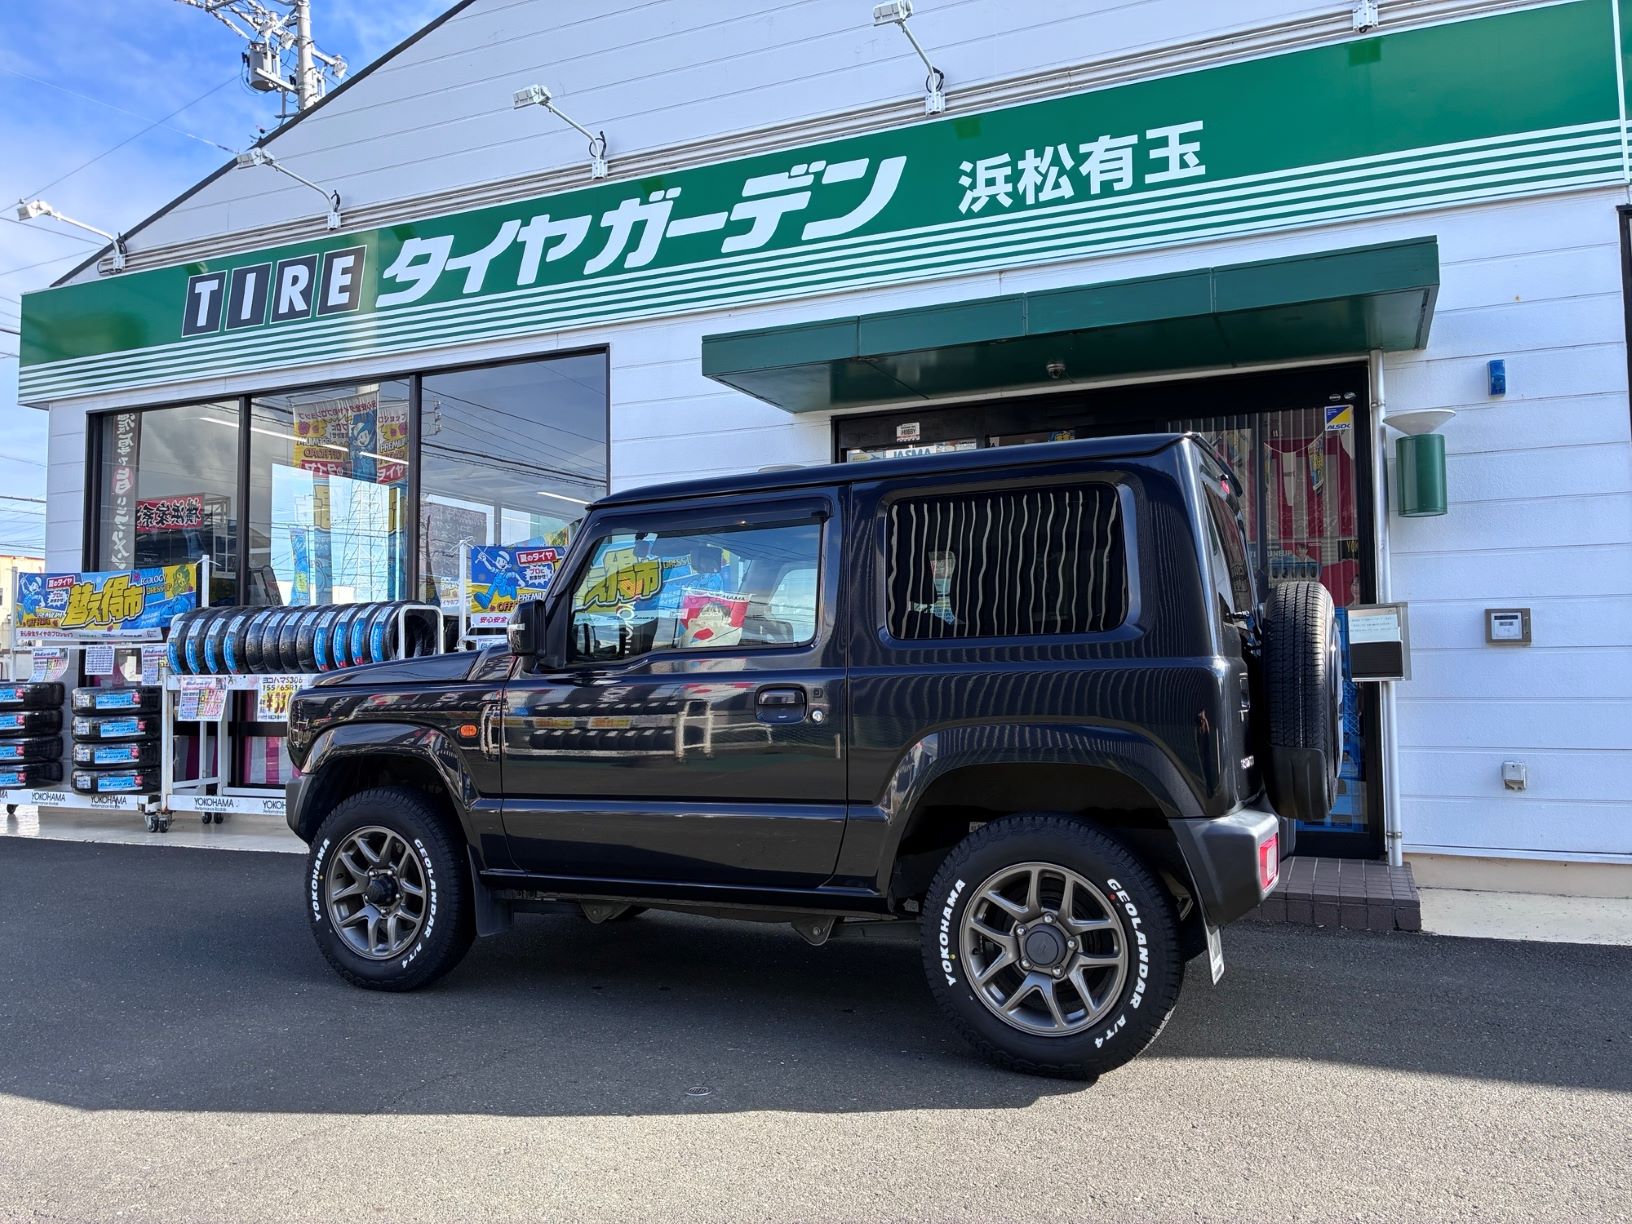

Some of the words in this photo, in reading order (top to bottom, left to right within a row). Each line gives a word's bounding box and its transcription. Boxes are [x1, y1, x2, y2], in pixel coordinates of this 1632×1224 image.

[958, 120, 1205, 214] 浜松有玉
[195, 255, 355, 326] TIRE
[378, 156, 907, 301] タイヤガーデン
[62, 575, 143, 627] 替え得市
[32, 792, 66, 802] YOKOHAMA
[91, 794, 127, 805] YOKOHAMA
[194, 797, 234, 807] YOKOHAMA
[311, 838, 330, 922] YOKOHAMA
[414, 838, 437, 938] GEOLANDAR
[939, 879, 966, 987] YOKOHAMA
[1107, 878, 1149, 1009] GEOLANDAR
